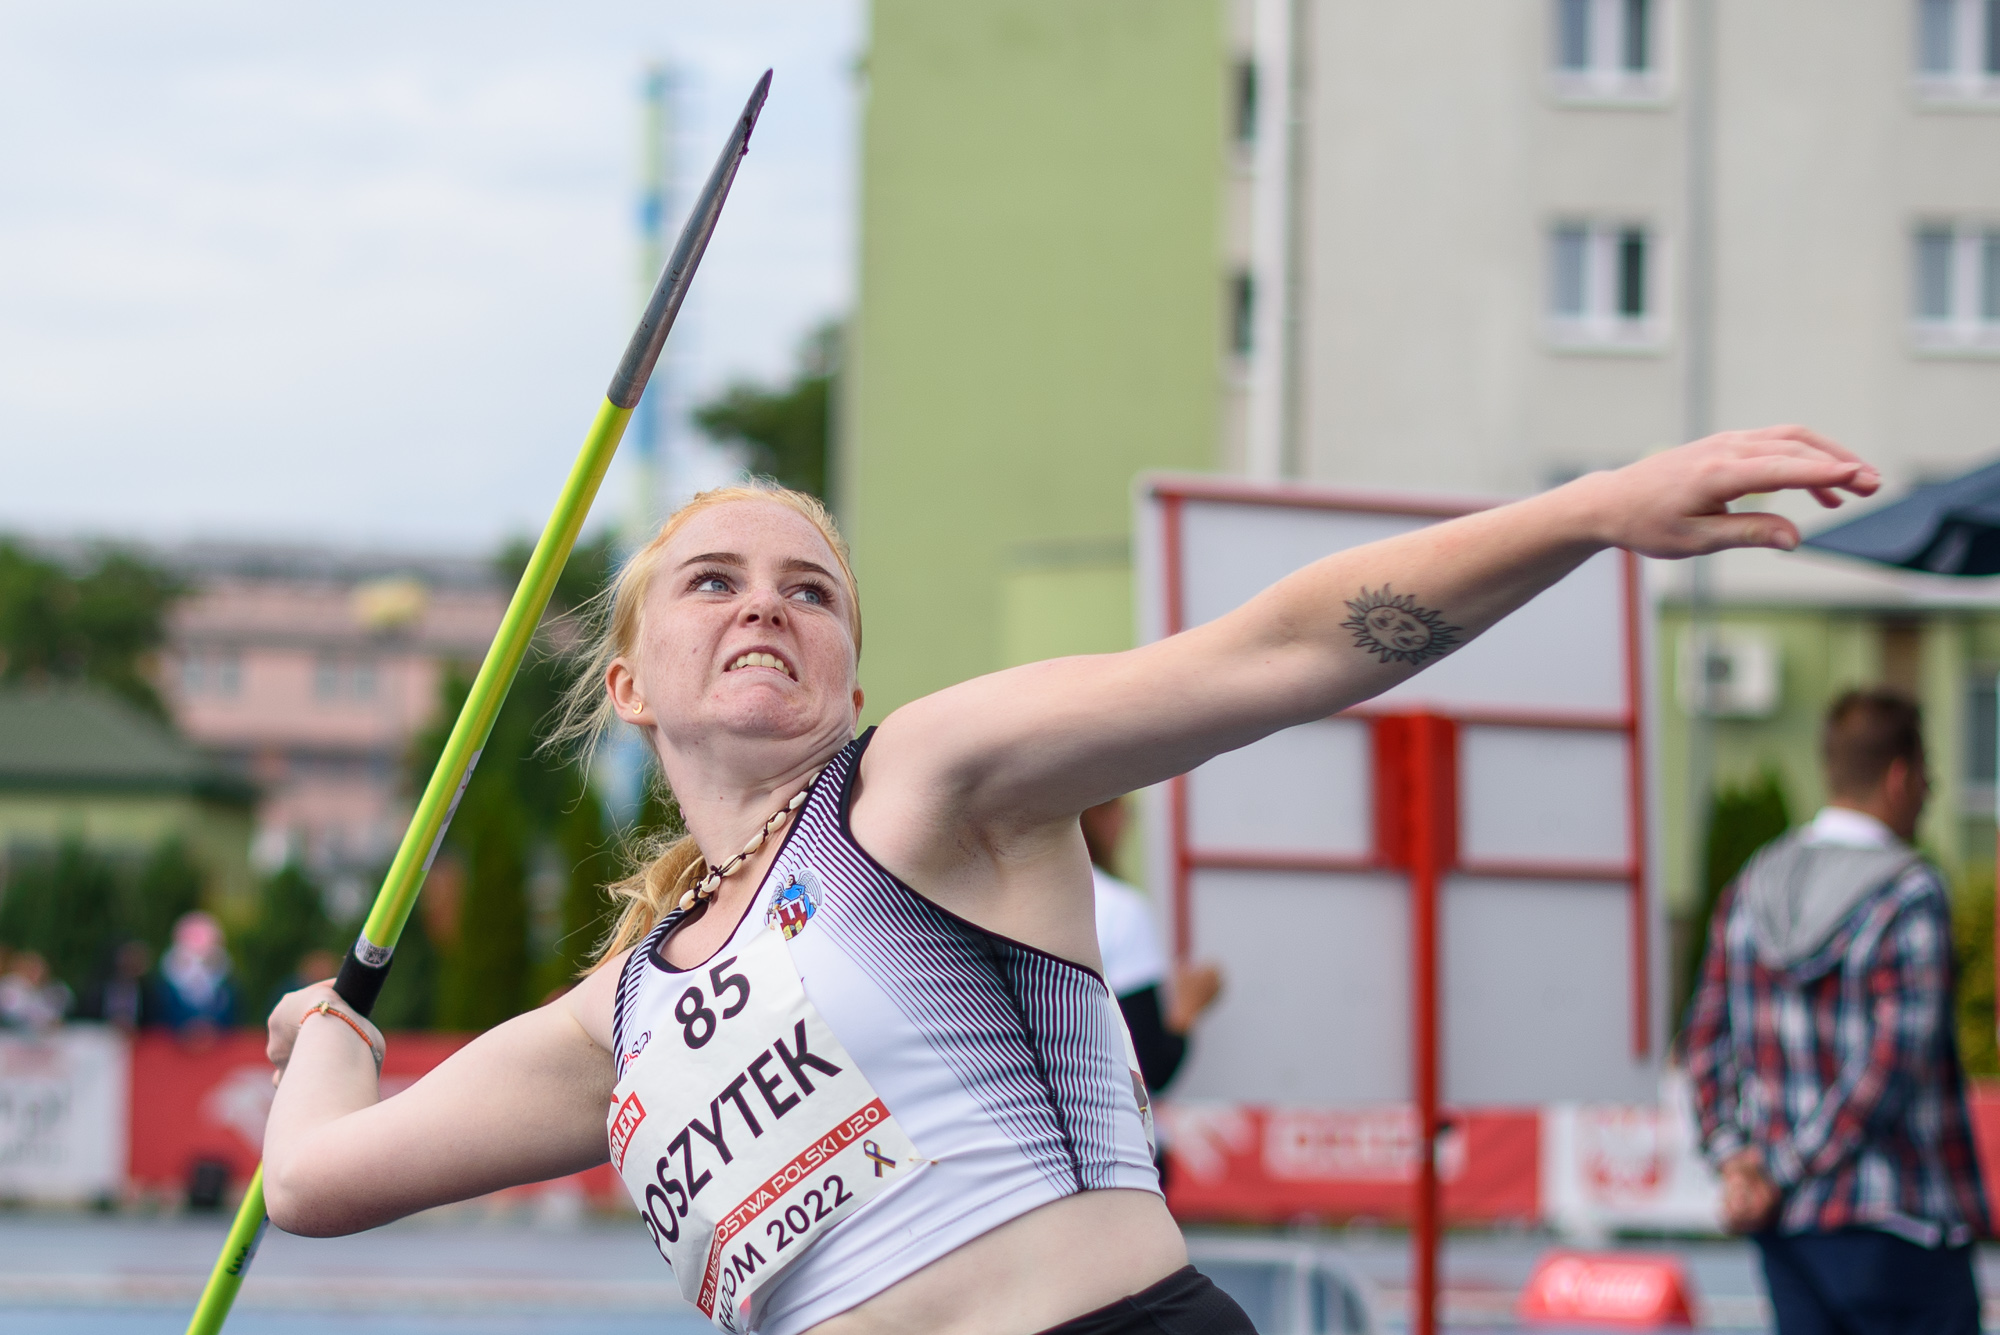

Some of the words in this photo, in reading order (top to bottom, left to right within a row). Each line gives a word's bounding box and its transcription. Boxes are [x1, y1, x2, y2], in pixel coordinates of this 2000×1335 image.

[675, 956, 751, 1049] 85
[612, 1099, 642, 1168] ORLEN
[771, 1136, 839, 1193] POLSKI
[837, 1107, 880, 1141] U20
[719, 1242, 767, 1335] RADOM
[767, 1174, 854, 1253] 2022
